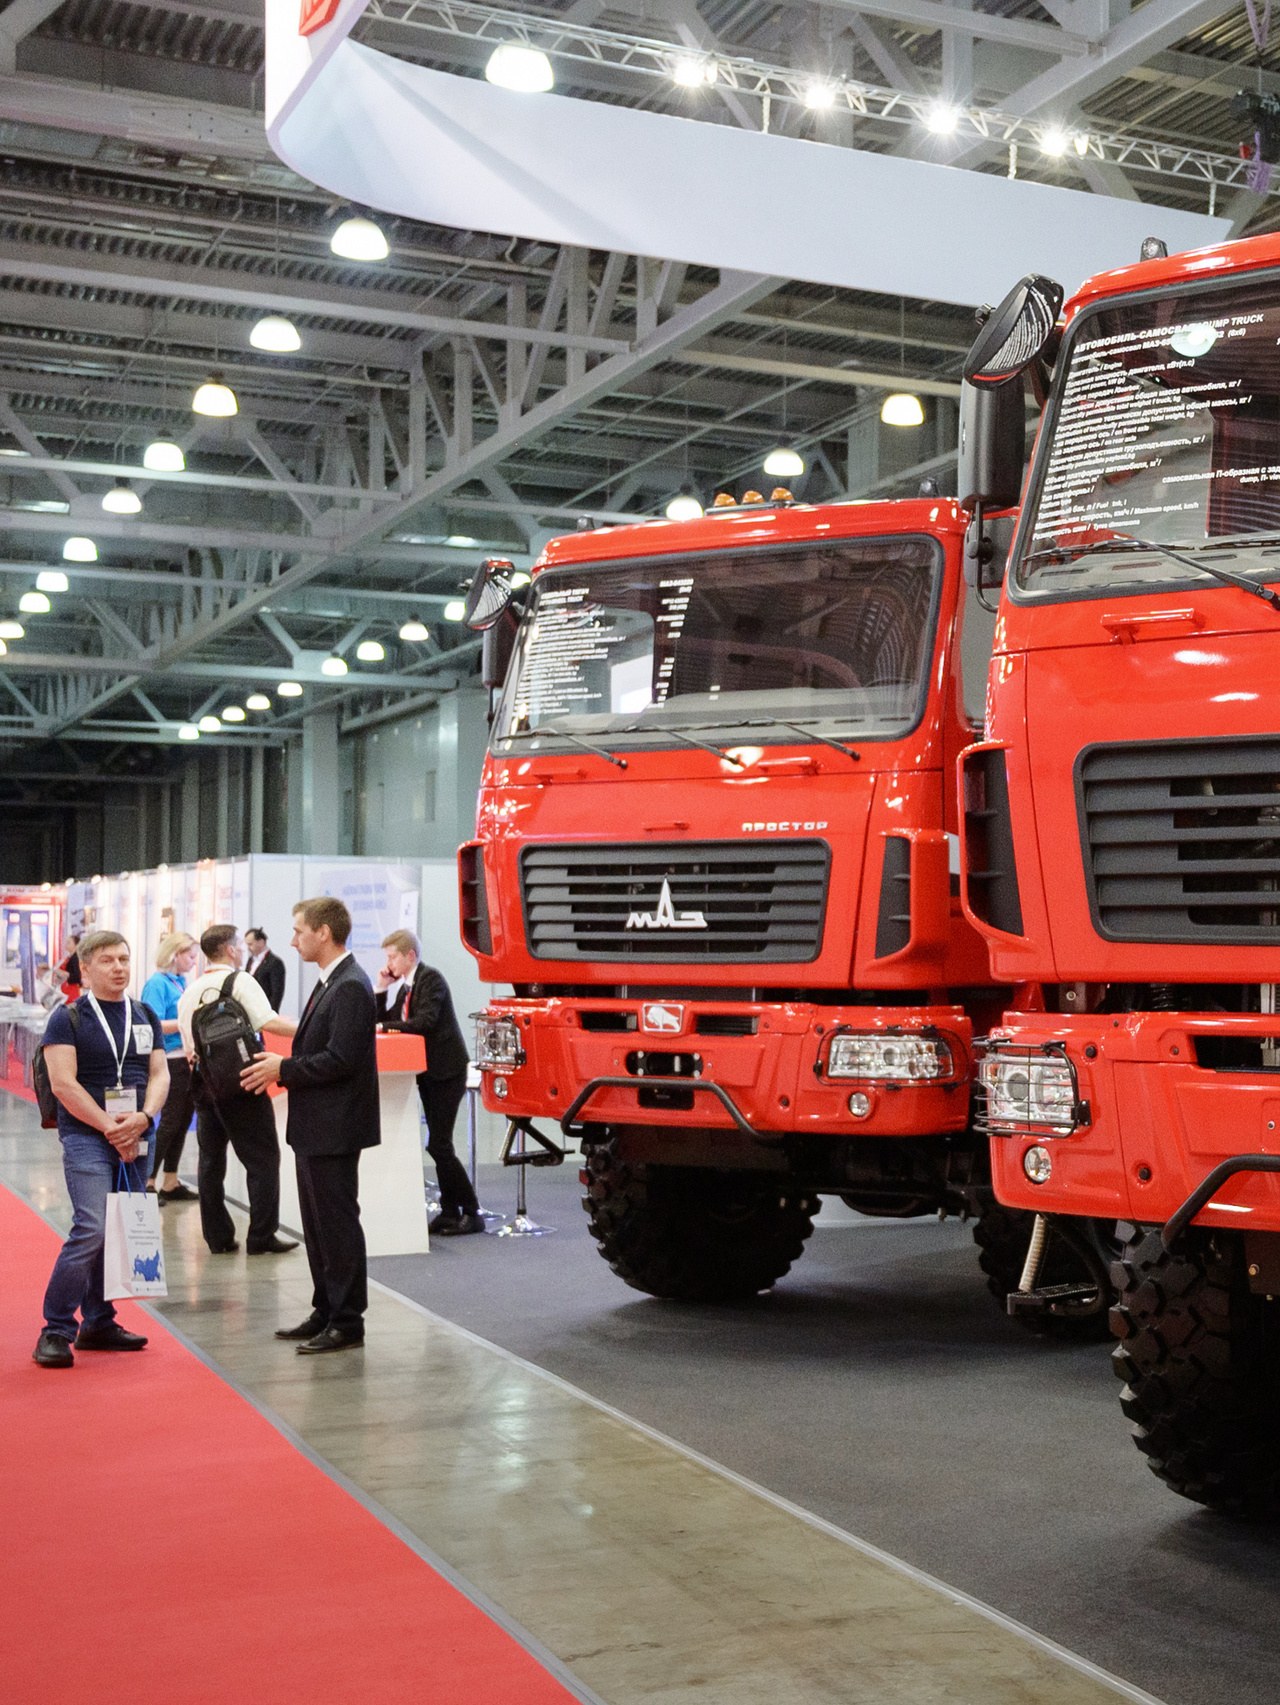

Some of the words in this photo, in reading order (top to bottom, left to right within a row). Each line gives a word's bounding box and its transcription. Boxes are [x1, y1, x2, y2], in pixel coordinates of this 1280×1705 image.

[1231, 314, 1263, 325] TRUCK
[1135, 391, 1157, 400] общая
[1159, 388, 1179, 396] масса
[1182, 382, 1227, 392] автомобиля,
[1142, 404, 1185, 415] допустимой
[1186, 401, 1210, 409] общей
[1216, 467, 1259, 477] П-образная
[626, 876, 708, 929] МАЗ
